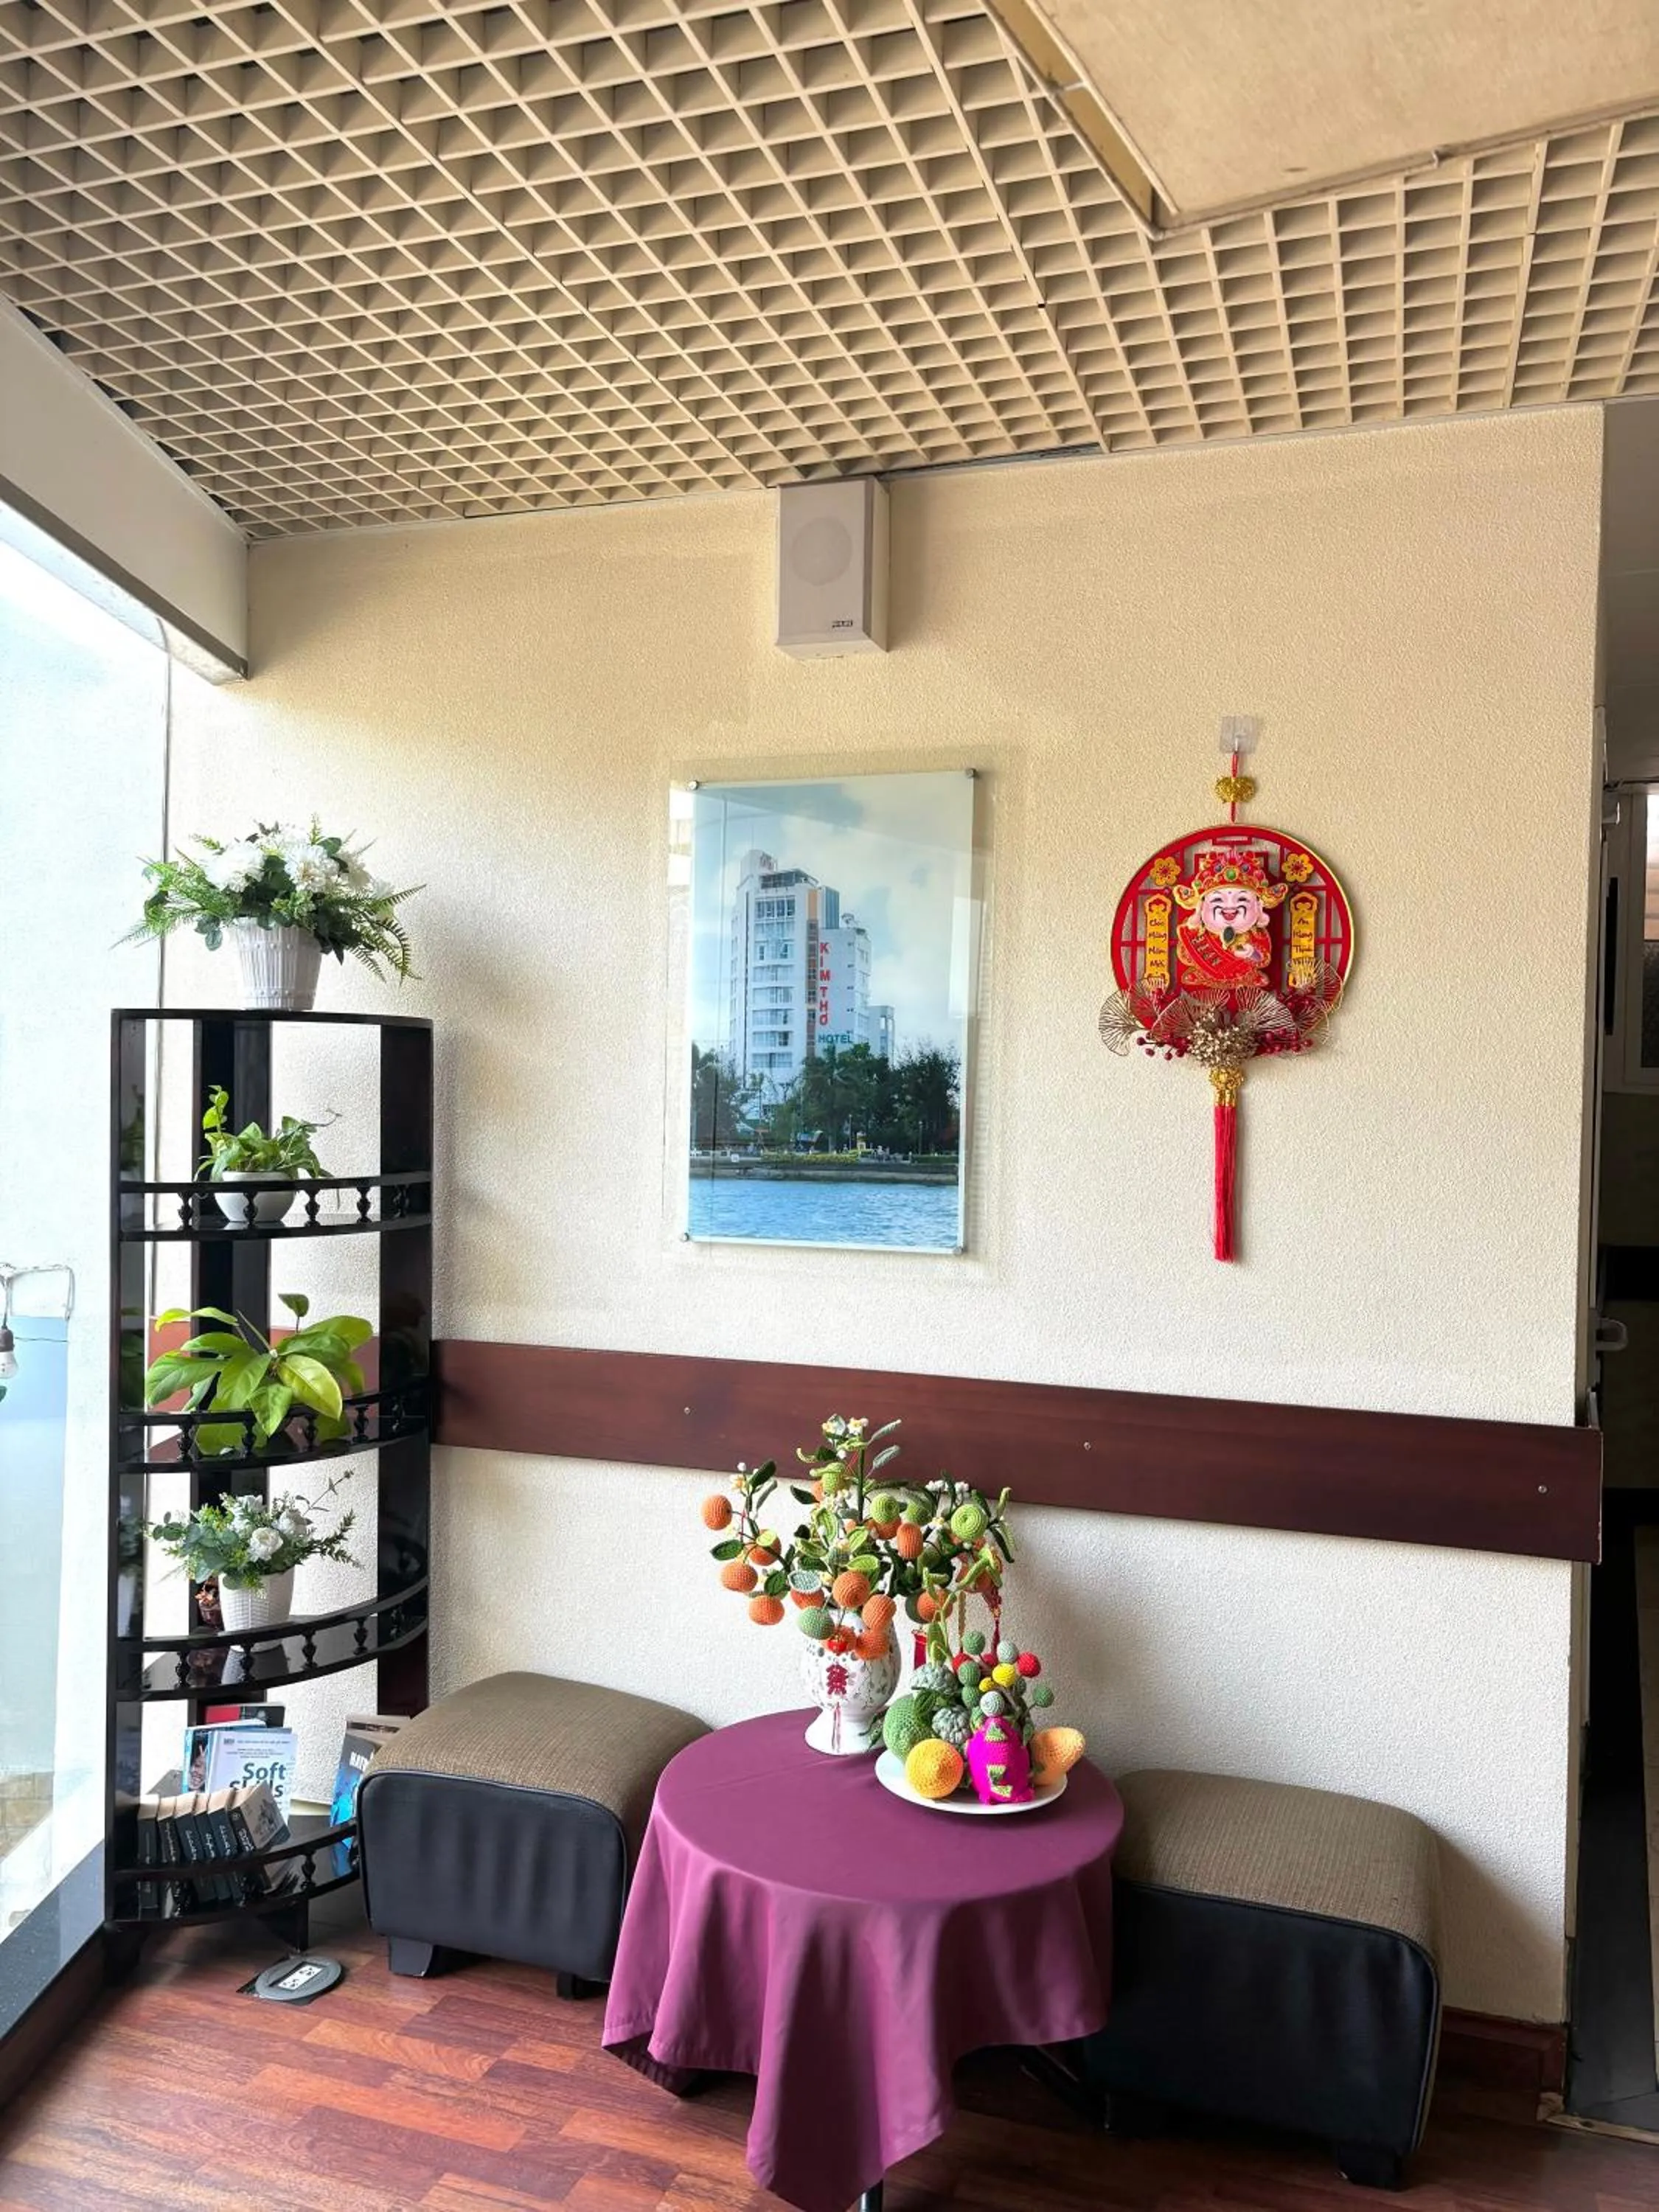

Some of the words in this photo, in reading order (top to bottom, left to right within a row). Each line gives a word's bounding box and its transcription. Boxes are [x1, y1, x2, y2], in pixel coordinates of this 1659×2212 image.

[820, 942, 830, 981] KIM
[818, 1034, 853, 1044] HOTEL
[242, 1761, 287, 1781] Soft
